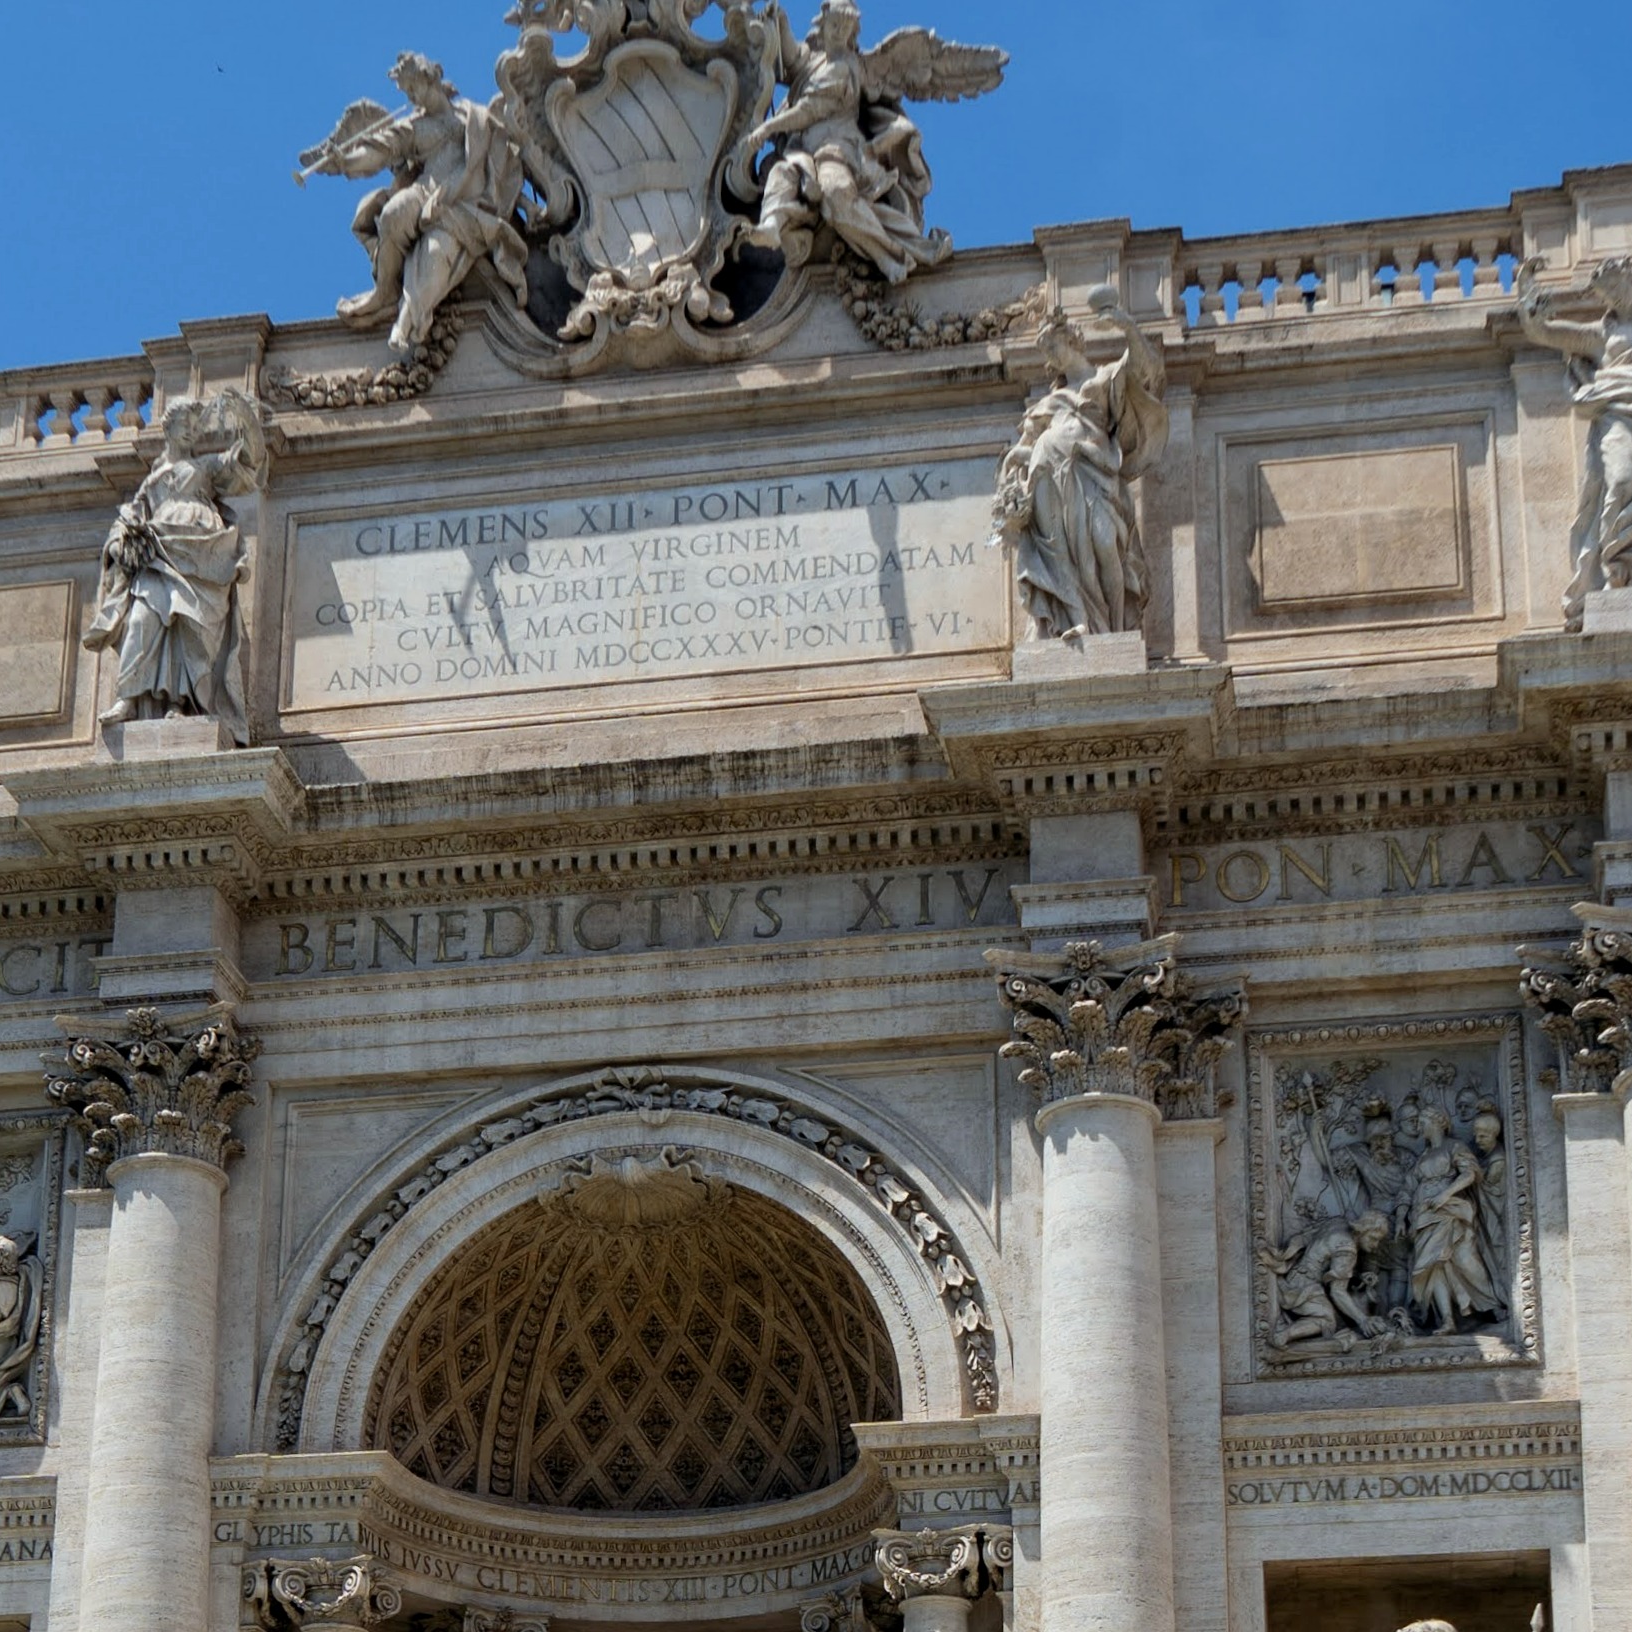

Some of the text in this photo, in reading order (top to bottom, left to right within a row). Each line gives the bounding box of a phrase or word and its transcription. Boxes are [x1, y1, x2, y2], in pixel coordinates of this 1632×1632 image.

[355, 508, 549, 556] CLEMENS
[484, 525, 801, 579] AQVAM VIRGINEM
[315, 542, 976, 626] COPIA ET SALVBRITATE COMMENDATAM
[397, 583, 892, 651] CVLTV MAGNIFICO ORNAVIT
[325, 662, 423, 692] ANNO
[434, 649, 558, 683] DOMINI
[274, 867, 1000, 976] BENEDICTVS XIV
[898, 1490, 924, 1513] NI
[1226, 1477, 1347, 1506] SOLVTVM
[401, 1546, 463, 1580] IVSSV
